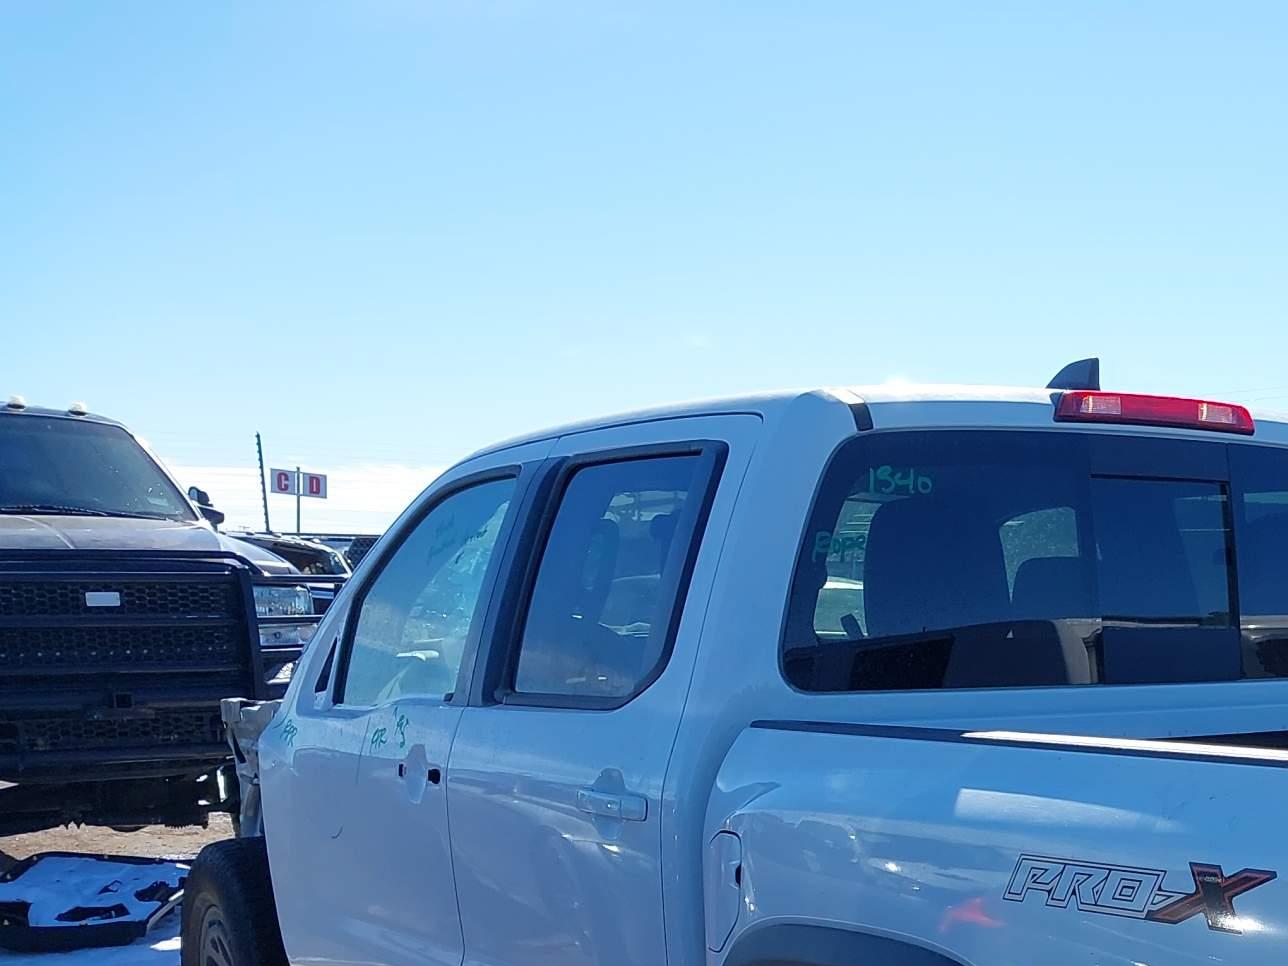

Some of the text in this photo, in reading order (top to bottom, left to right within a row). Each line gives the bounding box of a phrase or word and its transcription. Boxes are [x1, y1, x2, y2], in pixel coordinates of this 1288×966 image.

[277, 472, 320, 495] C D
[1002, 853, 1277, 934] PRO-X
